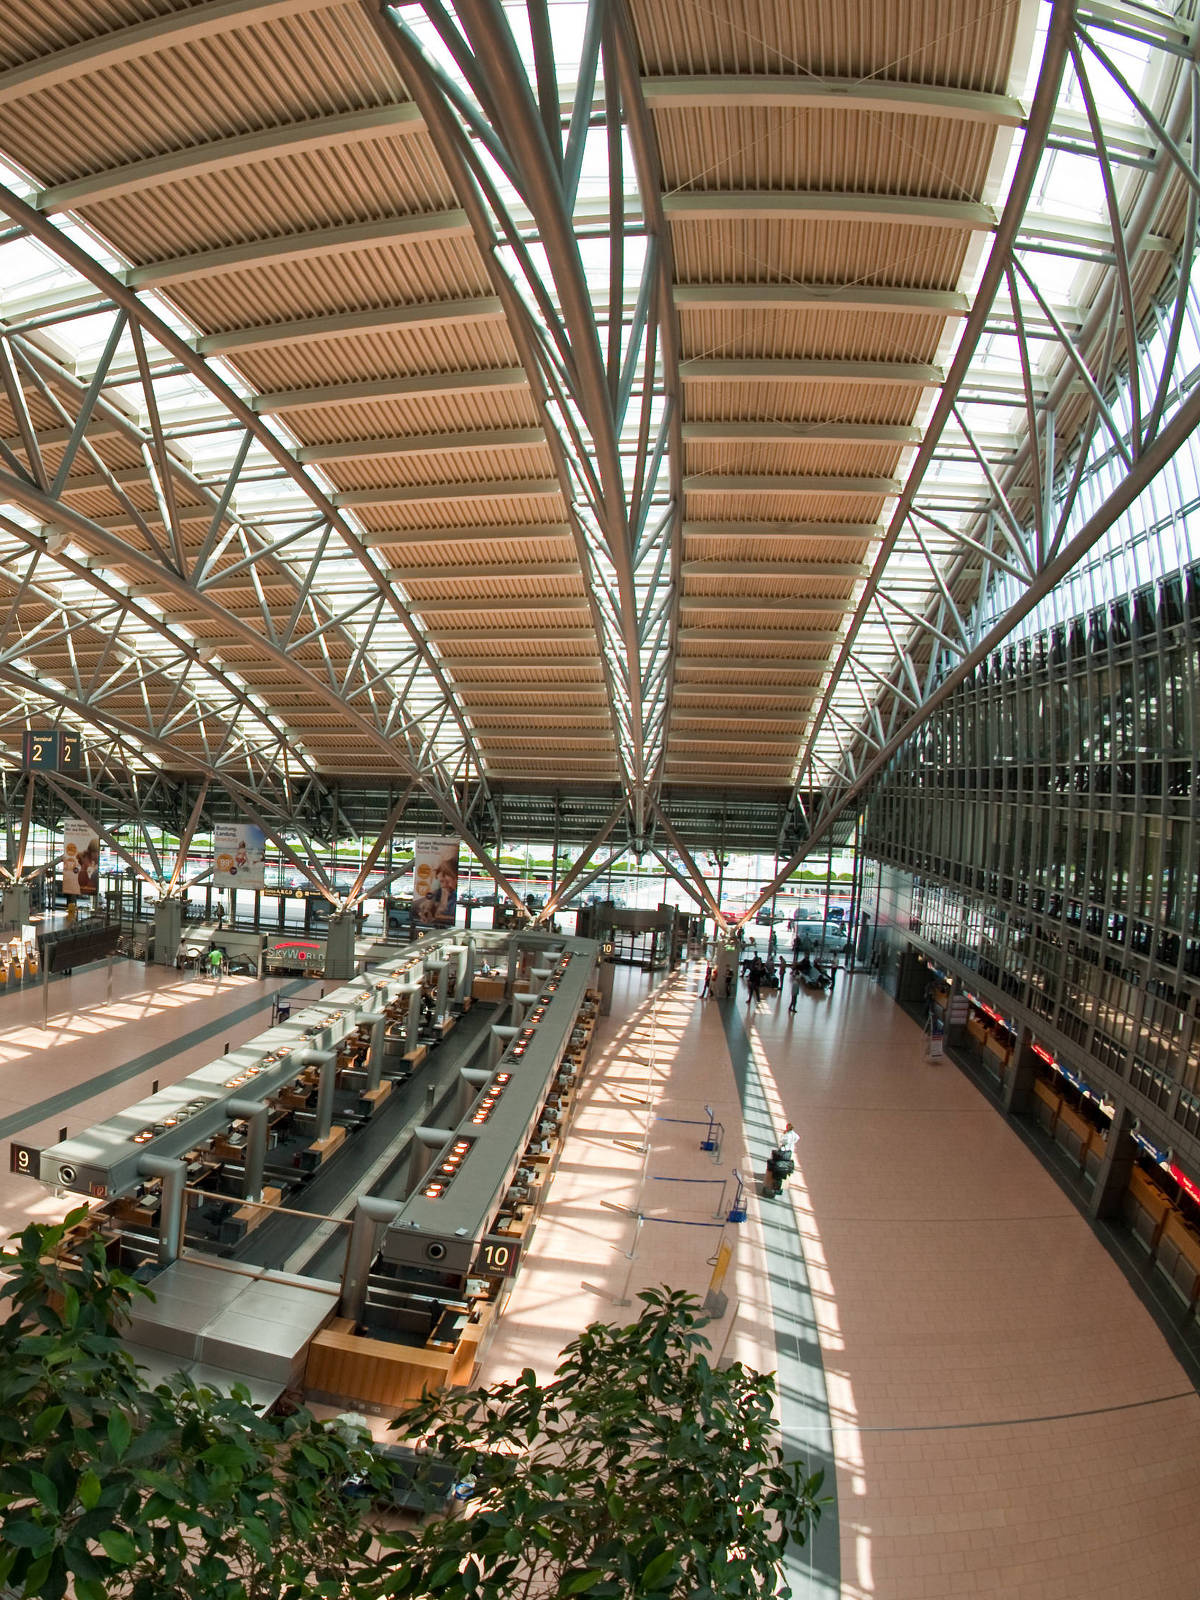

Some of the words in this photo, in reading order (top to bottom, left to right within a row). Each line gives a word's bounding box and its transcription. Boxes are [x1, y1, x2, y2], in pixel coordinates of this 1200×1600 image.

[33, 744, 43, 761] 2
[64, 745, 71, 762] 2
[603, 944, 612, 953] 10
[18, 1150, 29, 1168] 9
[485, 1246, 509, 1266] 10
